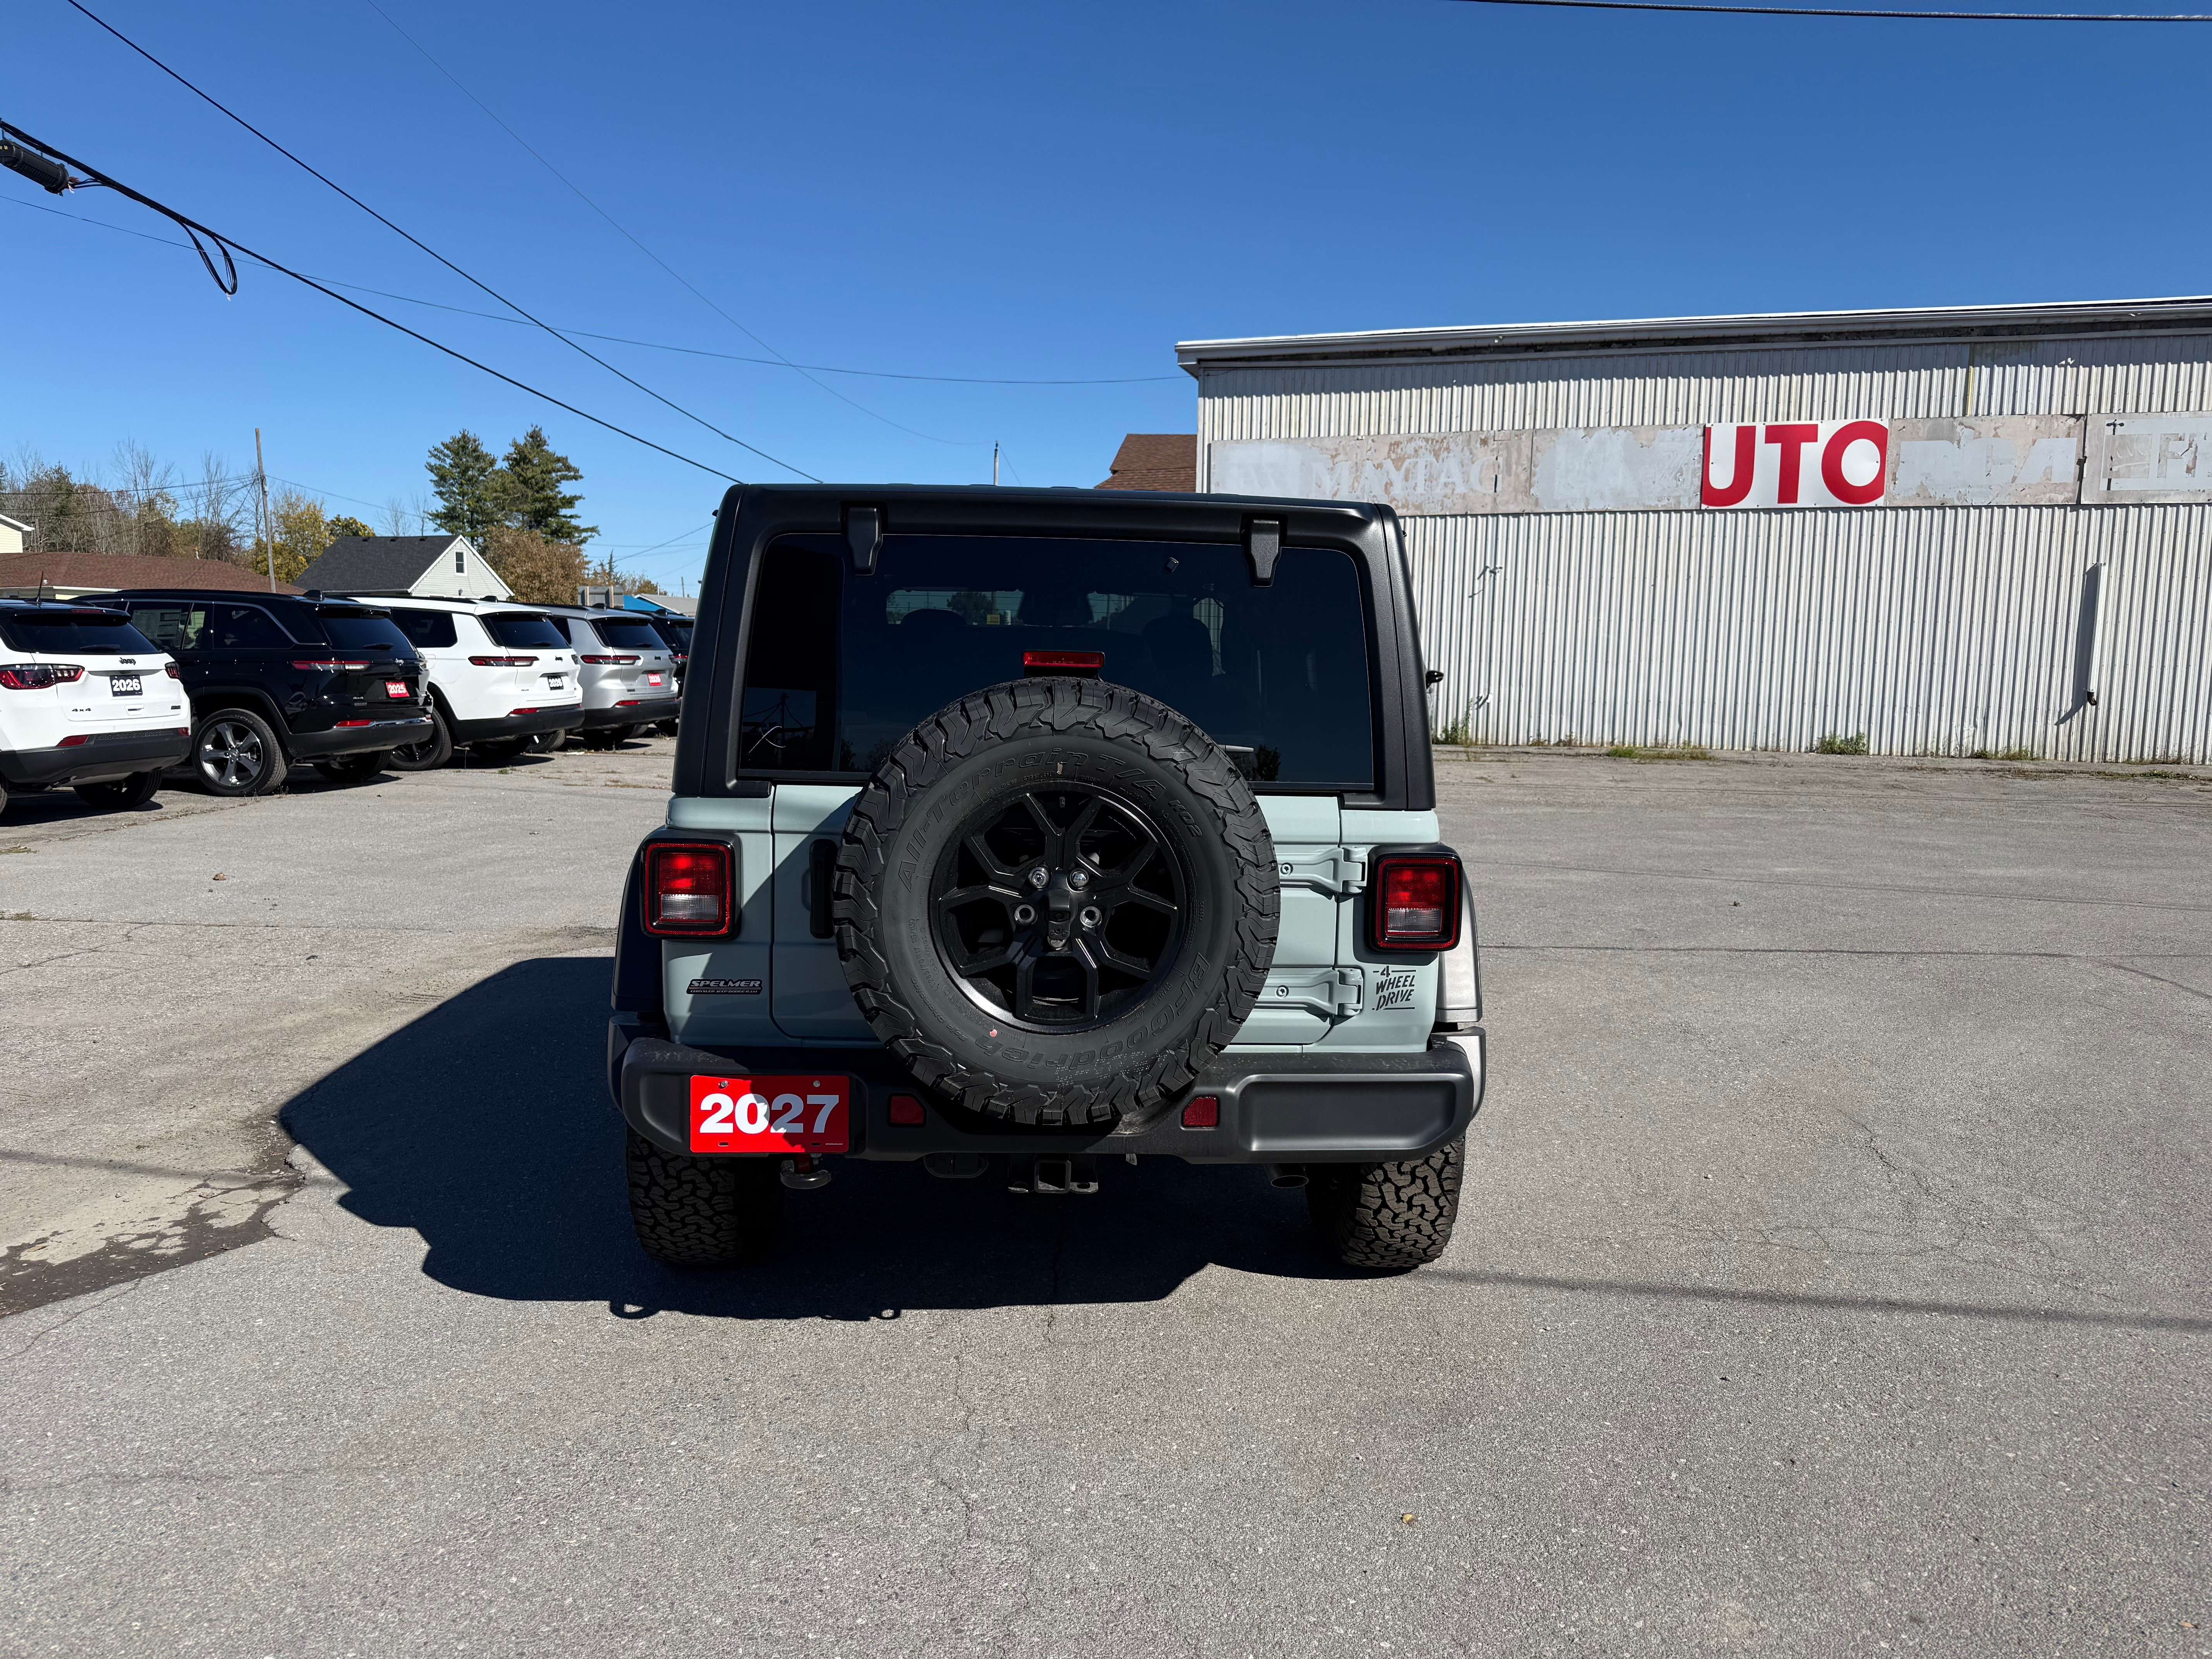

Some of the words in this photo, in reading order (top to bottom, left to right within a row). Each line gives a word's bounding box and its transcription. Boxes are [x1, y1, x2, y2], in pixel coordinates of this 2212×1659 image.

[1702, 420, 1888, 507] UTO
[112, 679, 141, 691] 2026
[388, 684, 407, 694] 2025
[1380, 965, 1390, 977] 4
[1376, 974, 1415, 995] WHEEL
[1376, 988, 1413, 1011] DRIVE
[699, 1093, 839, 1134] 2027
